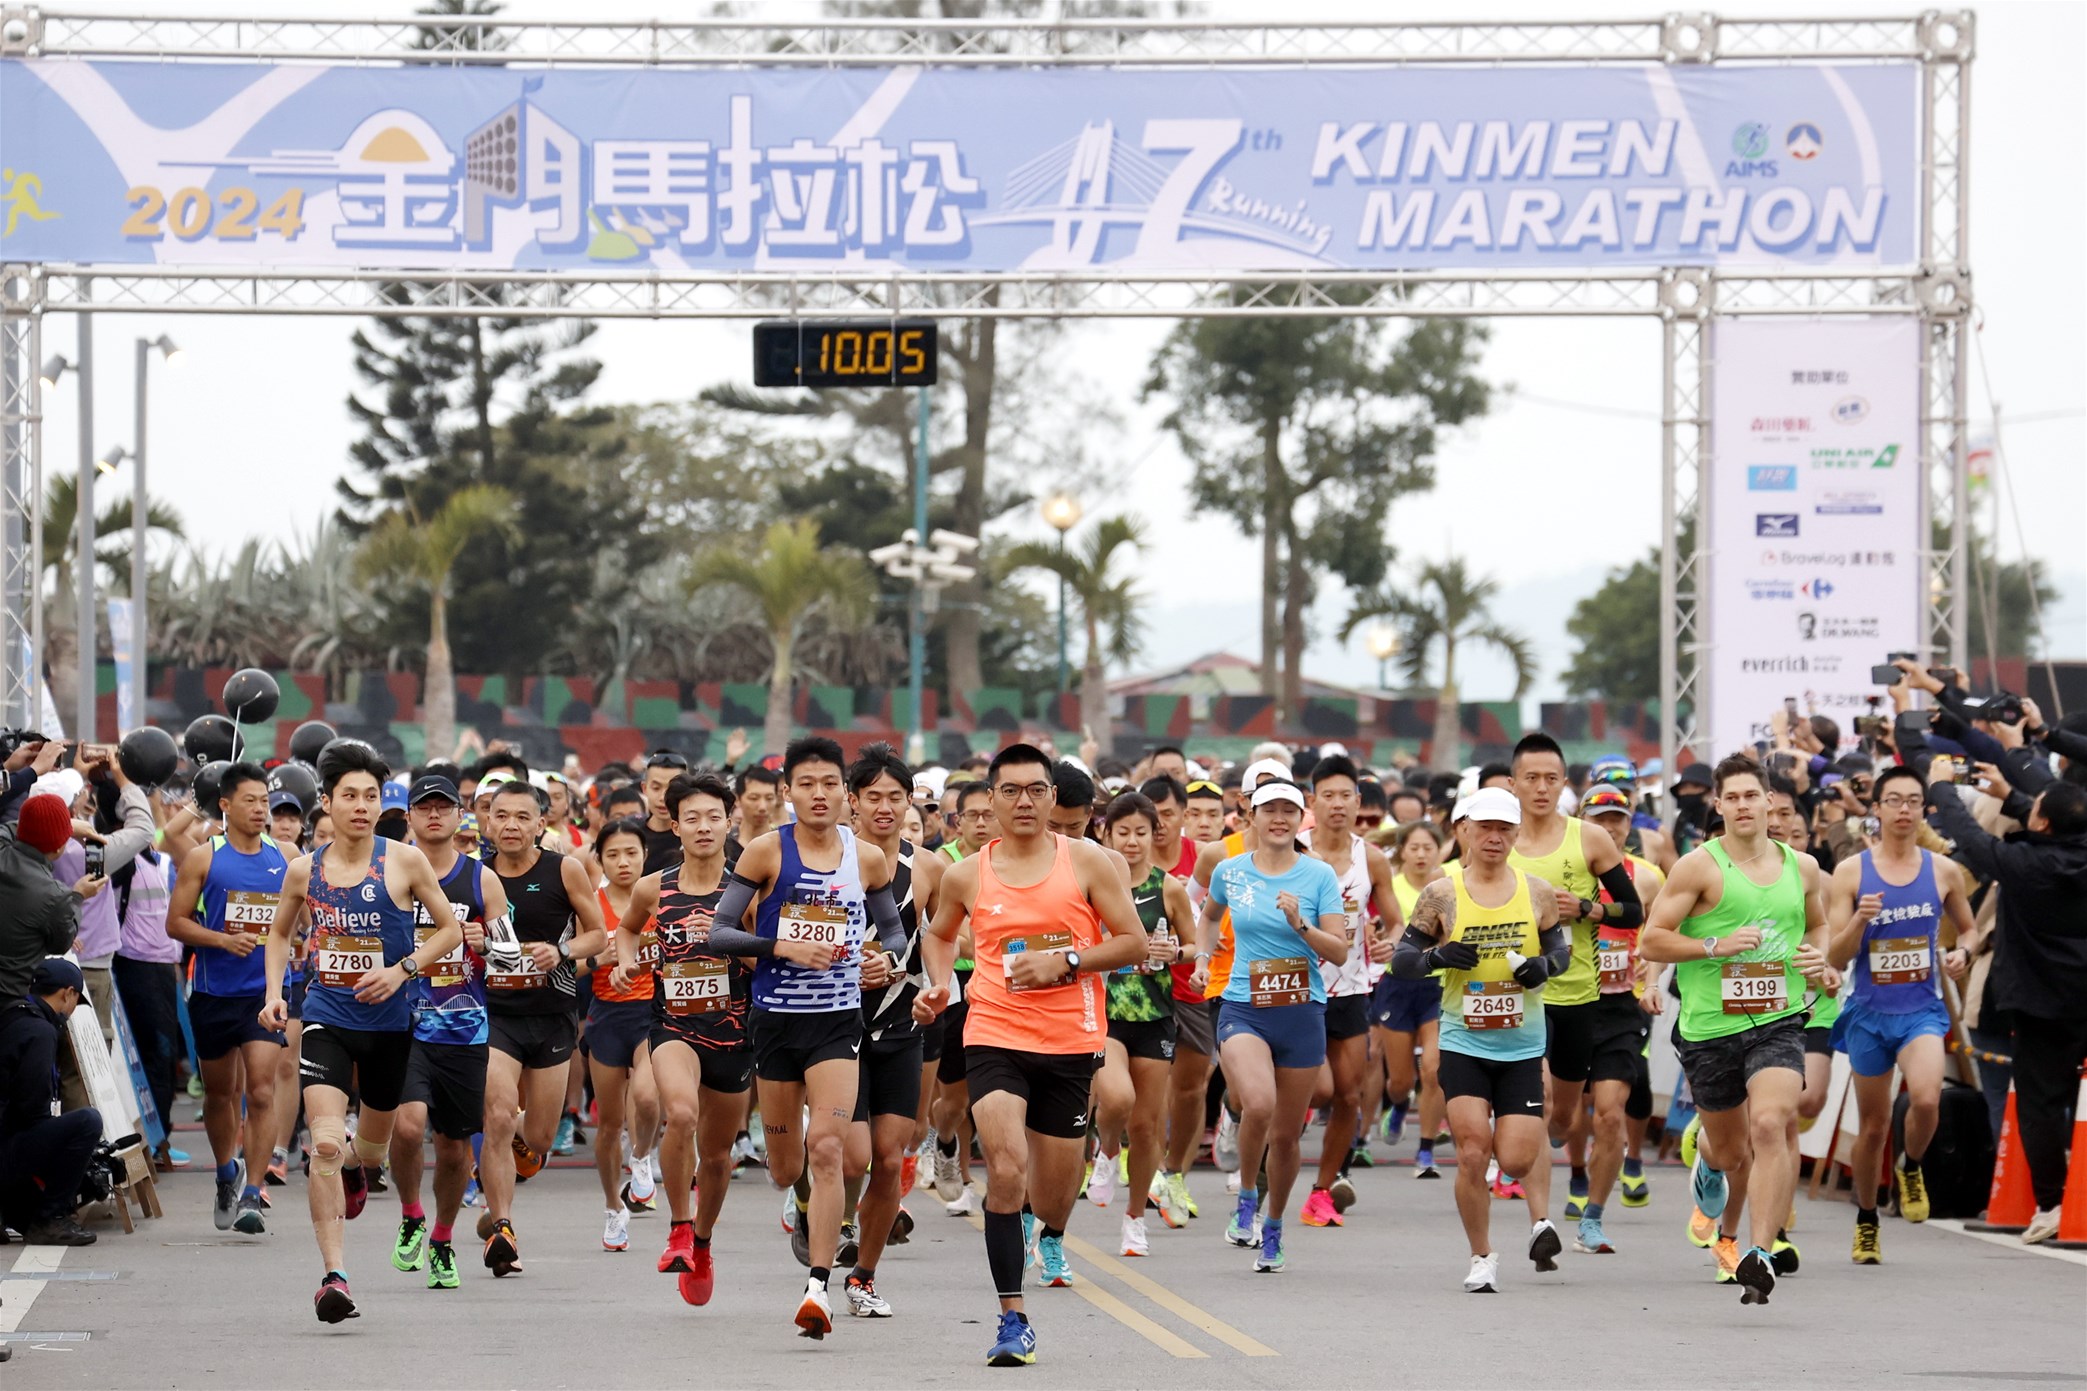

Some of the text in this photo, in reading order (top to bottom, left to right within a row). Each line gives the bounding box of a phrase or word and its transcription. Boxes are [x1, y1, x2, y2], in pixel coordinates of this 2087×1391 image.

[1311, 119, 1684, 185] KINMEN
[330, 82, 982, 256] 金門馬拉松
[1725, 160, 1779, 177] AIMS
[121, 184, 307, 243] 2024
[1207, 176, 1334, 253] Running
[1356, 185, 1887, 253] MARATHON
[234, 906, 274, 922] 2132
[314, 906, 381, 928] Believe
[789, 922, 836, 943] 3280
[328, 953, 374, 971] 2780
[1880, 953, 1921, 970] 2203
[673, 978, 719, 998] 2875
[1259, 973, 1301, 991] 4474
[1733, 979, 1777, 997] 3199
[1472, 997, 1515, 1014] 2649
